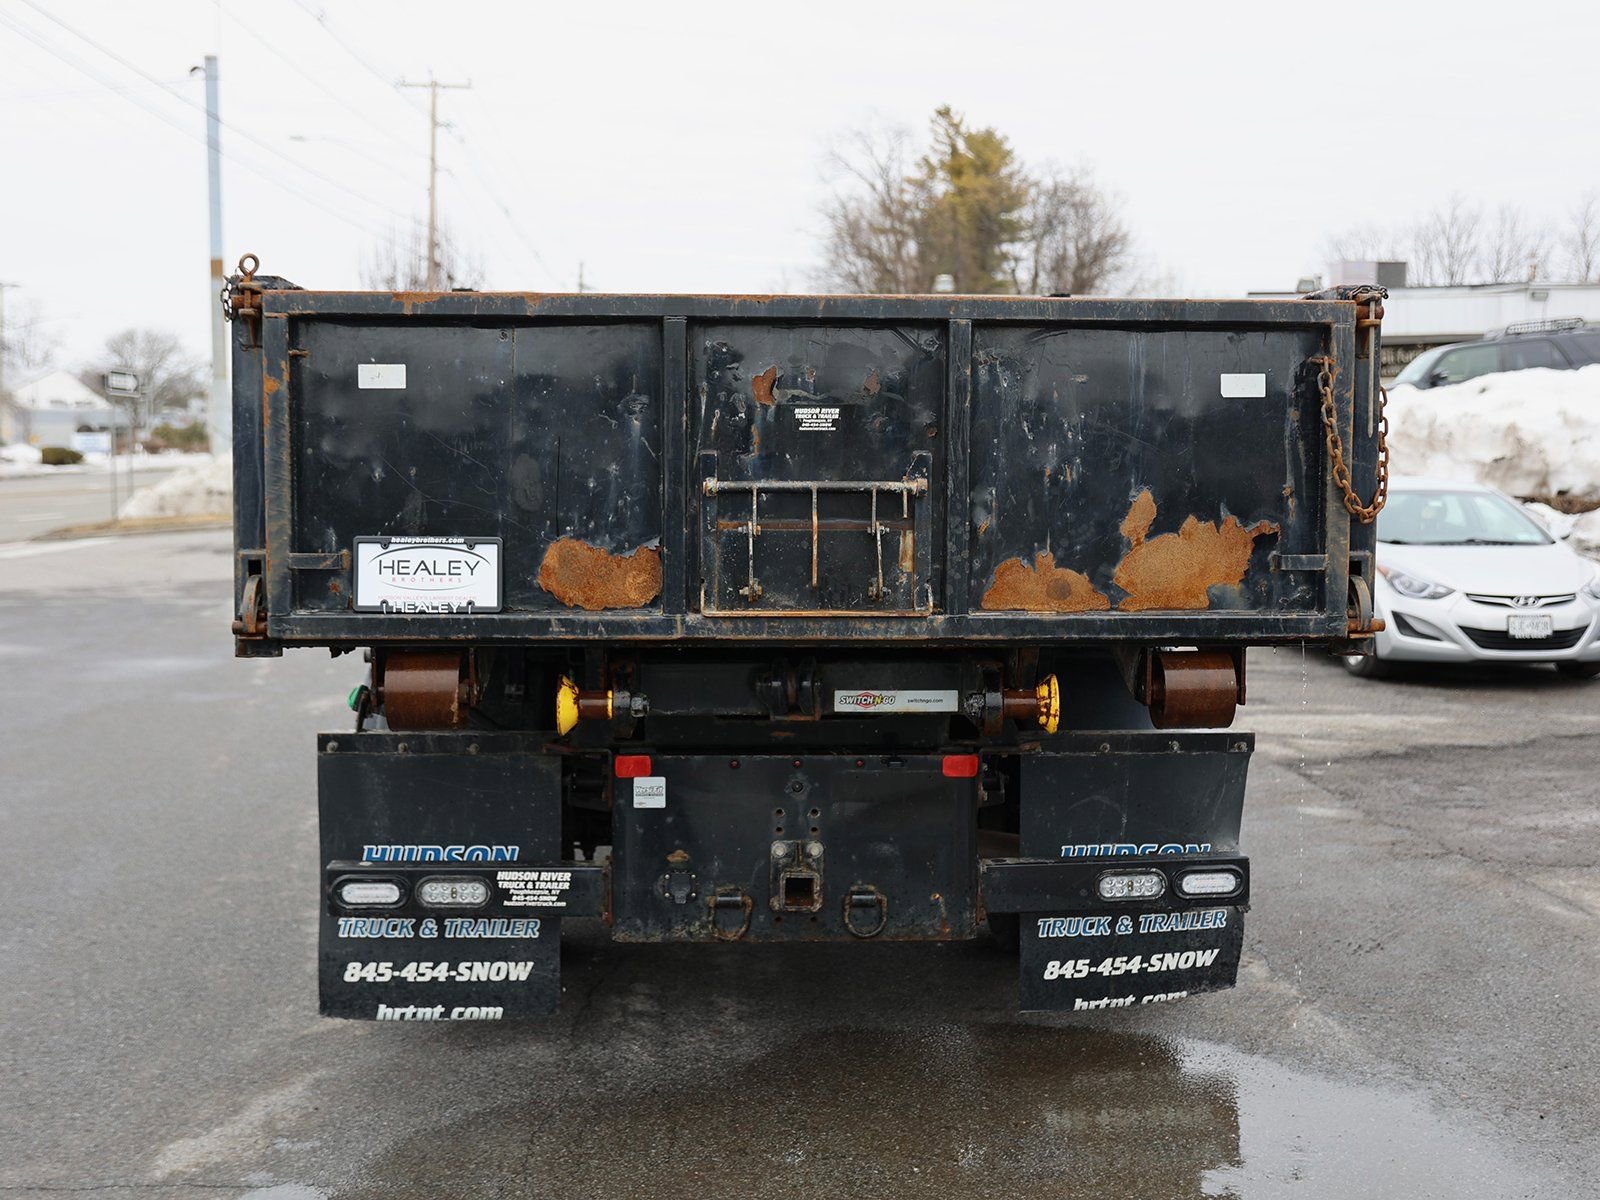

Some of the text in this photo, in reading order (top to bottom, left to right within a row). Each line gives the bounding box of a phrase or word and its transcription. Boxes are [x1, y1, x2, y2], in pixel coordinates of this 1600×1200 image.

[391, 536, 465, 544] healeybrothers.com
[379, 560, 480, 576] HEALEY
[391, 601, 462, 613] HEALEY
[496, 871, 572, 881] HUDSON RIVER
[498, 881, 526, 889] TRUCK
[534, 882, 570, 890] TRAILER
[338, 918, 541, 938] TRUCK & TRAILER
[1037, 909, 1228, 938] TRUCK & TRAILER
[343, 961, 534, 983] 845-454-SNOW
[1043, 949, 1220, 980] 845-454-SNOW
